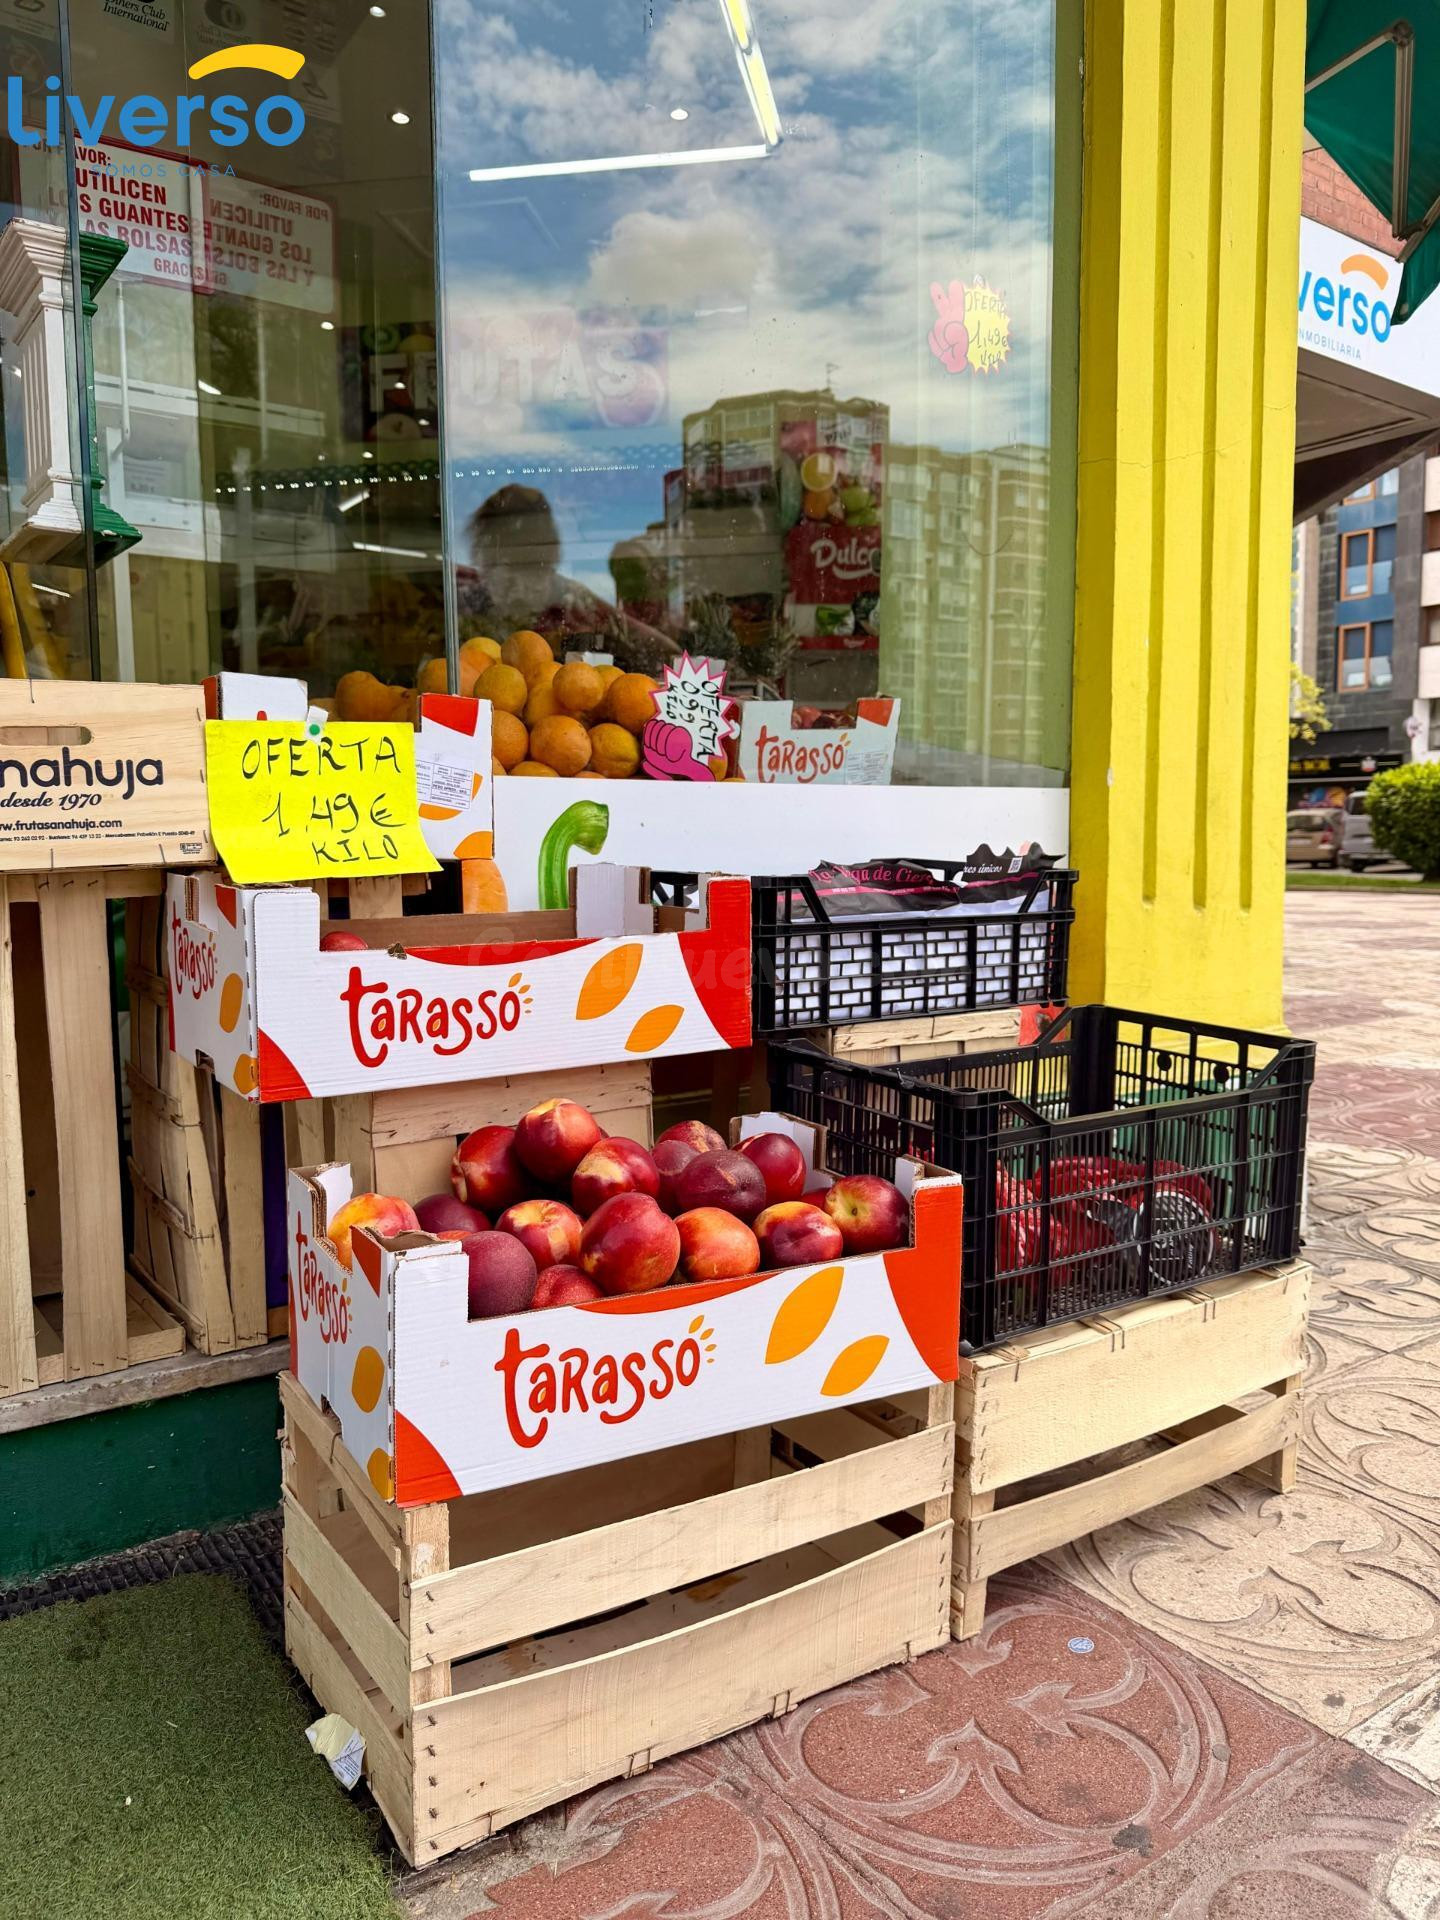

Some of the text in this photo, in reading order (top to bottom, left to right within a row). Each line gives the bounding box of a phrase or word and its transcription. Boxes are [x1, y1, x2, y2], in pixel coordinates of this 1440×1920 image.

[103, 2, 170, 31] International
[142, 4, 166, 20] Club
[75, 167, 167, 206] UTILICEN
[98, 197, 190, 234] GUANTES
[117, 225, 192, 258] BOLSAS
[666, 683, 679, 720] KILO
[696, 680, 721, 760] OFERTA
[241, 735, 402, 780] OFERTA
[0, 792, 103, 811] desde 1970
[311, 834, 399, 866] KILO
[872, 866, 893, 881] de
